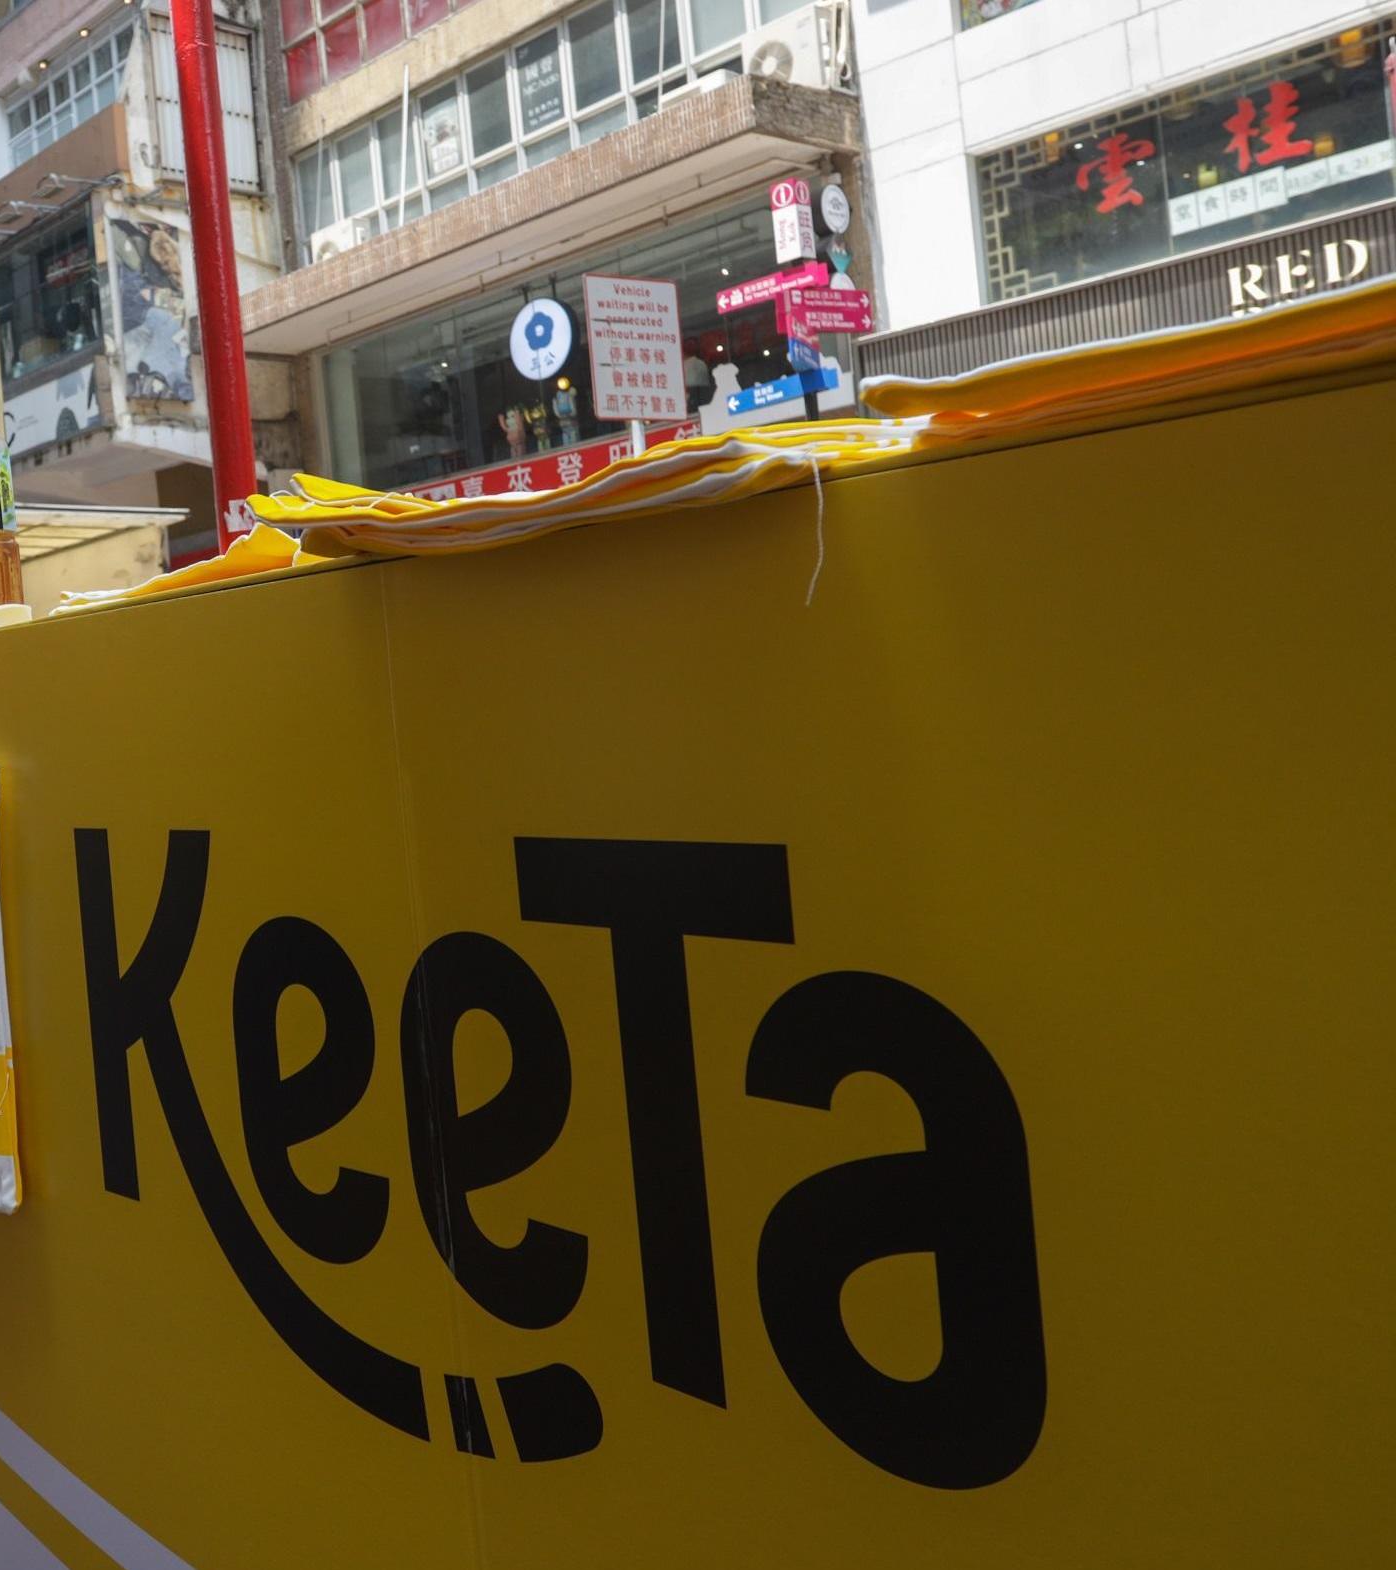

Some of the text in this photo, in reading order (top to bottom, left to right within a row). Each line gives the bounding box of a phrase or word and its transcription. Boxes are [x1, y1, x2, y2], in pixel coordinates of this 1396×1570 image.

[1227, 239, 1369, 307] RED
[613, 284, 651, 297] Vehicle
[597, 300, 669, 313] waiting will be
[637, 332, 677, 344] warning
[610, 347, 666, 364] 停車等候
[605, 393, 676, 415] 而不予警告
